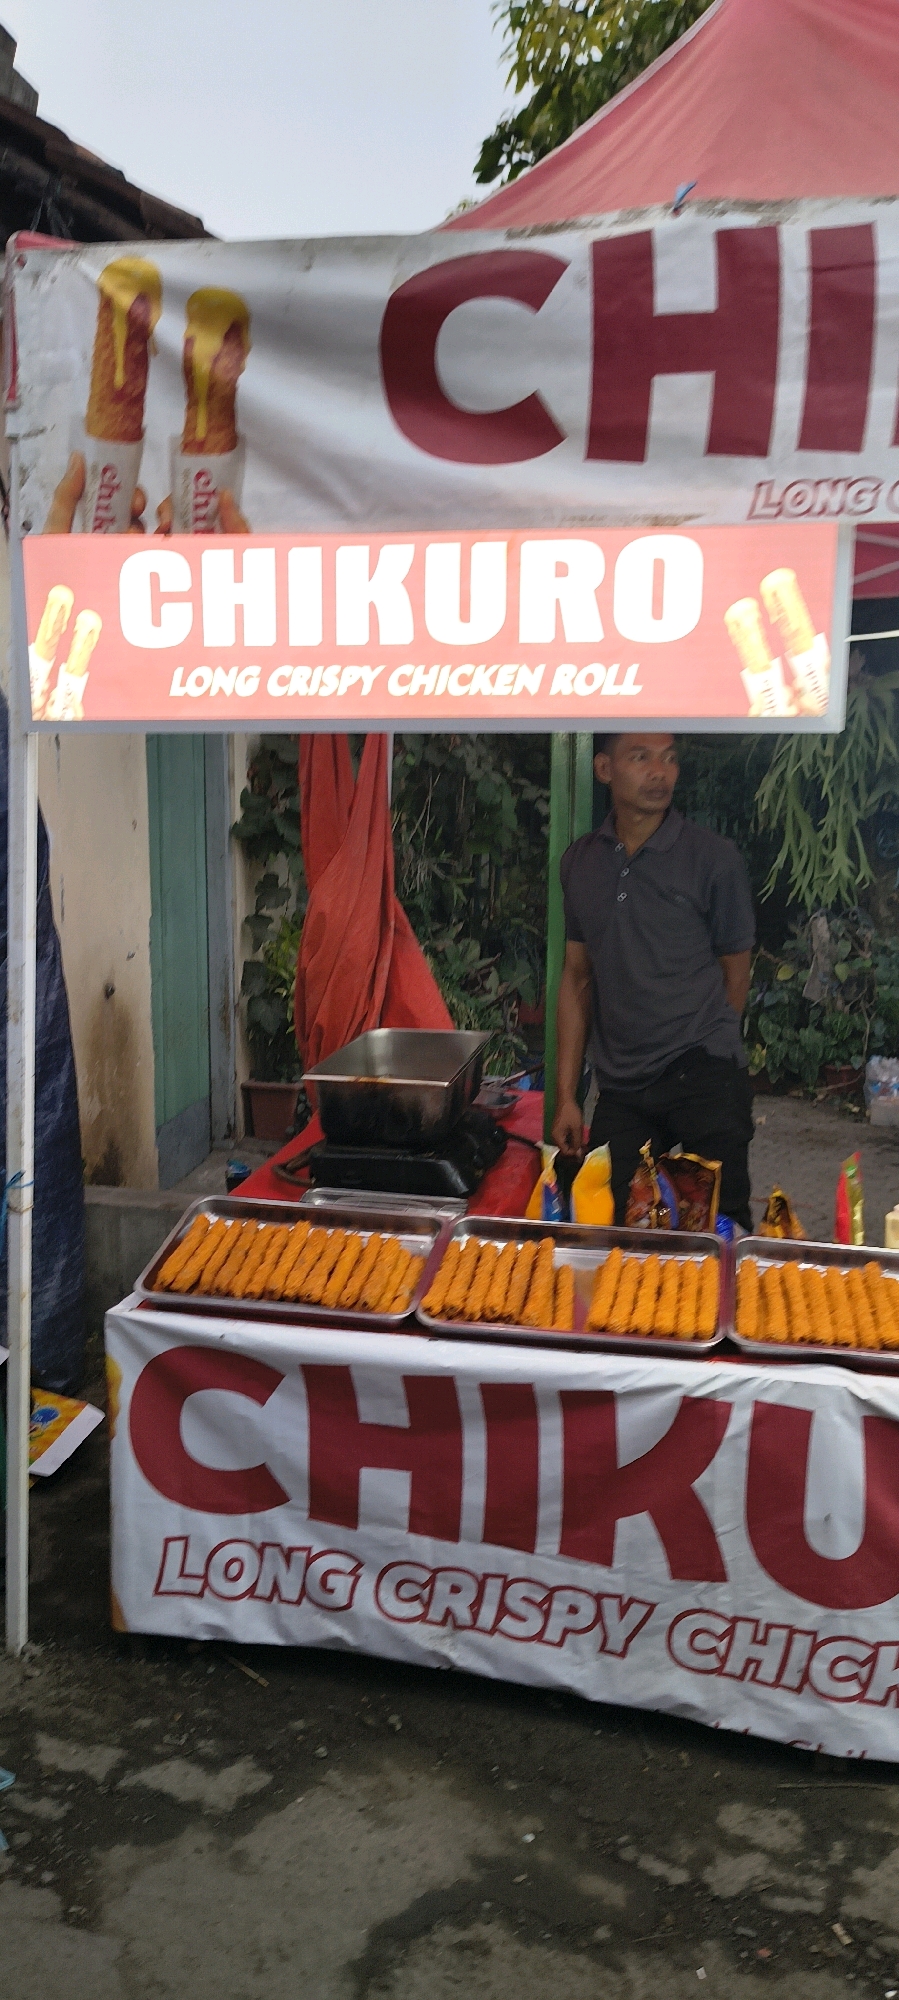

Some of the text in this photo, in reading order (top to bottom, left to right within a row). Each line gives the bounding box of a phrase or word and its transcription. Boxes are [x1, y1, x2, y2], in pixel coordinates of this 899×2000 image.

[380, 224, 899, 467] CHI
[747, 476, 885, 520] LONG
[119, 534, 704, 649] CHIKURO
[169, 662, 643, 697] LONG CRISPY CHICKEN ROLL
[129, 1345, 899, 1610] CHIKU
[154, 1535, 364, 1612] LONG
[375, 1560, 659, 1658] CRISPY
